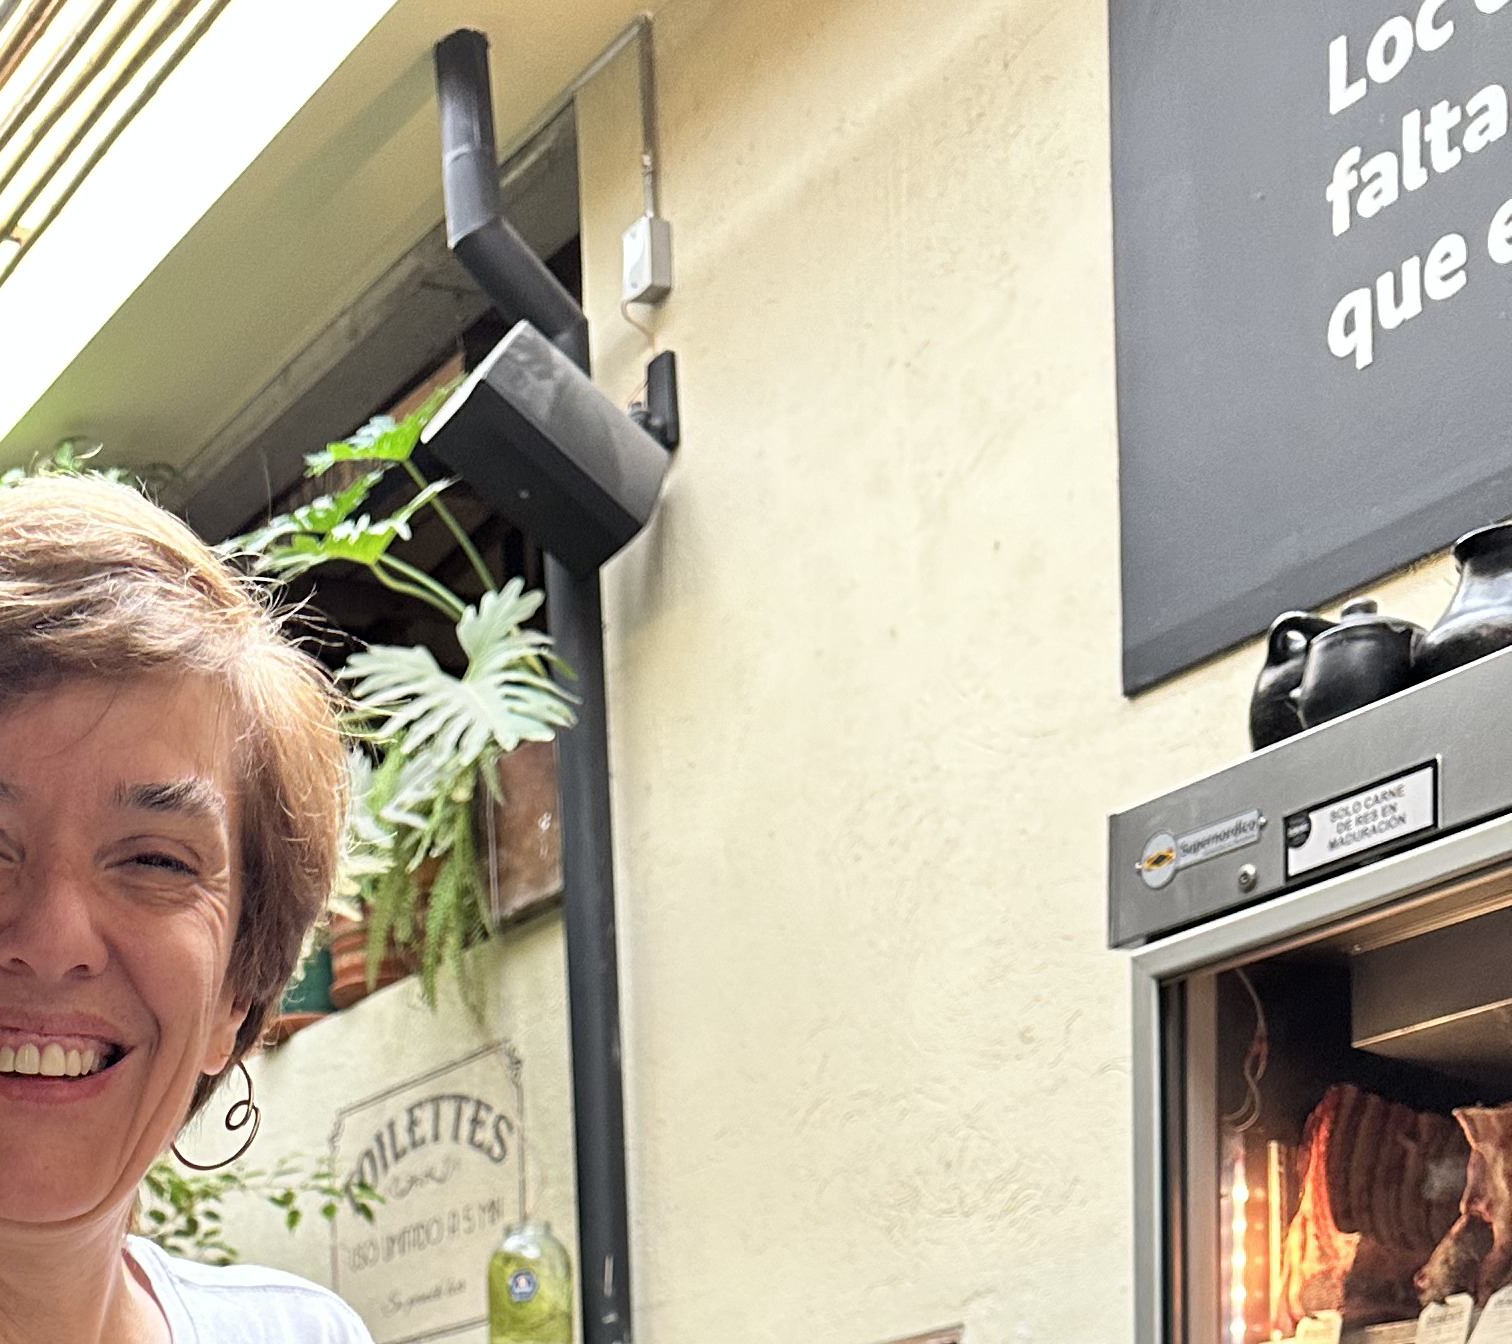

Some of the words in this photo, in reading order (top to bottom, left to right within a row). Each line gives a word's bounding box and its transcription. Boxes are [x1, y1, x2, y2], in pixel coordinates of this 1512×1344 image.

[1325, 84, 1509, 237] falta
[1327, 233, 1468, 370] que
[1330, 800, 1362, 823] SOLO
[1364, 783, 1406, 809] CARNE
[1336, 818, 1353, 835] DE
[1381, 801, 1398, 818] EN
